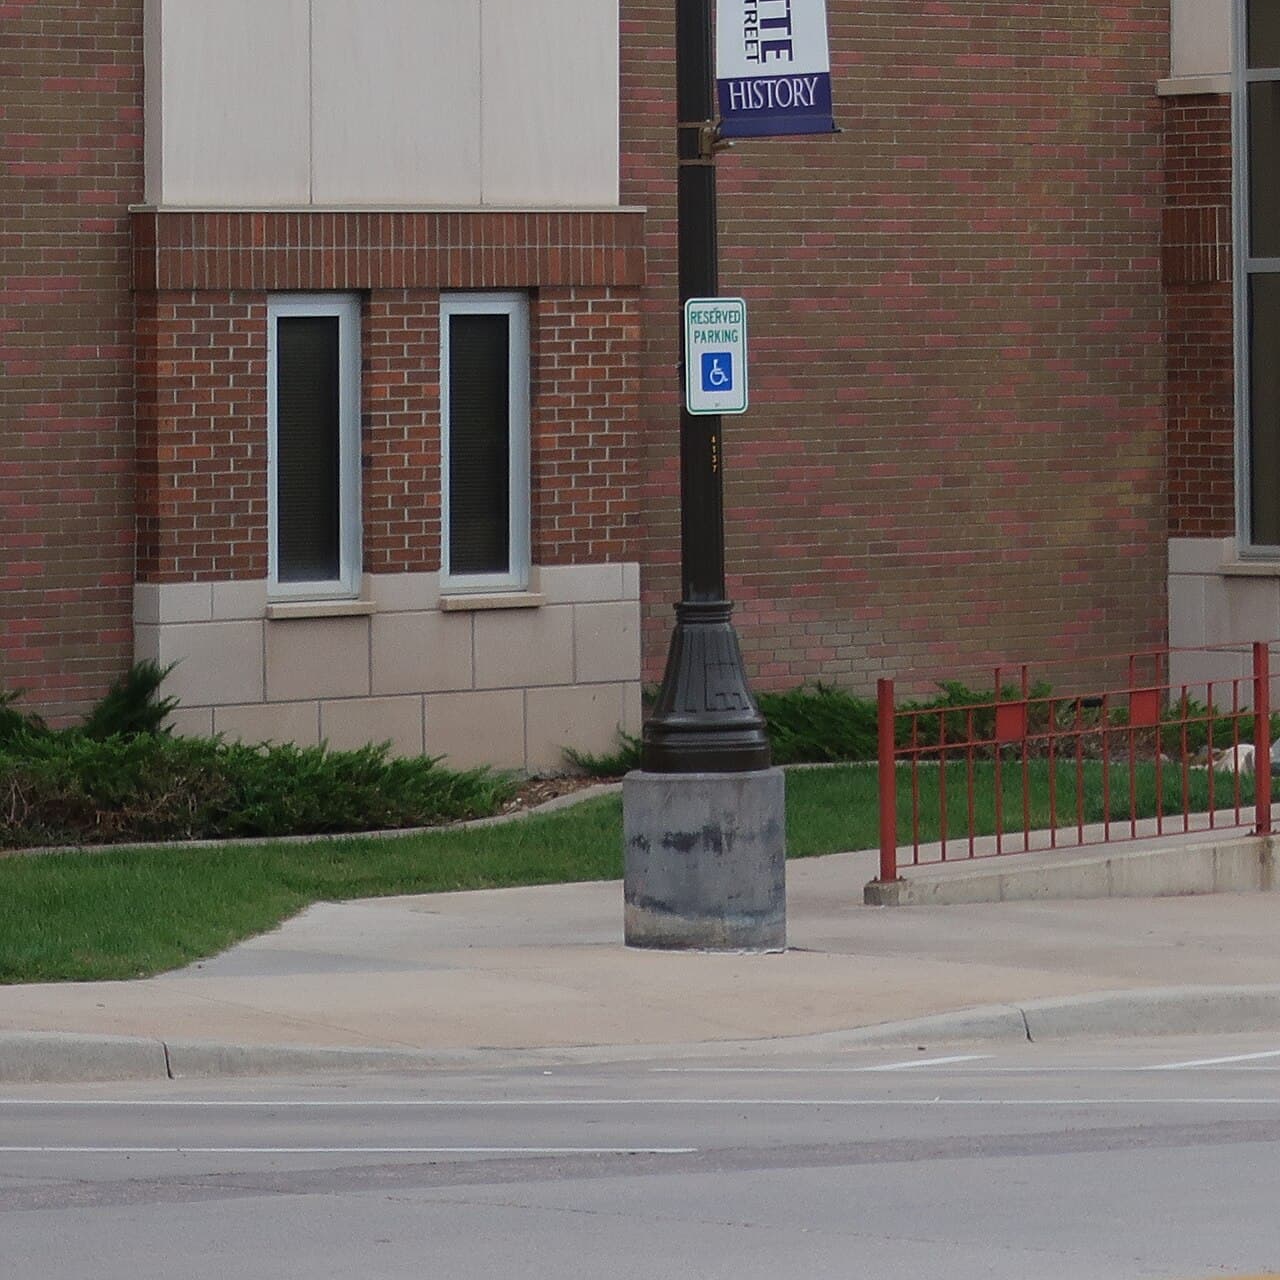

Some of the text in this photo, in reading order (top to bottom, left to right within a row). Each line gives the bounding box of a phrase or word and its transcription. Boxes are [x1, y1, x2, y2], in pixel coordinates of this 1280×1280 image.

[728, 77, 818, 110] HISTORY
[690, 310, 741, 324] RESERVED
[694, 329, 738, 343] PARKING
